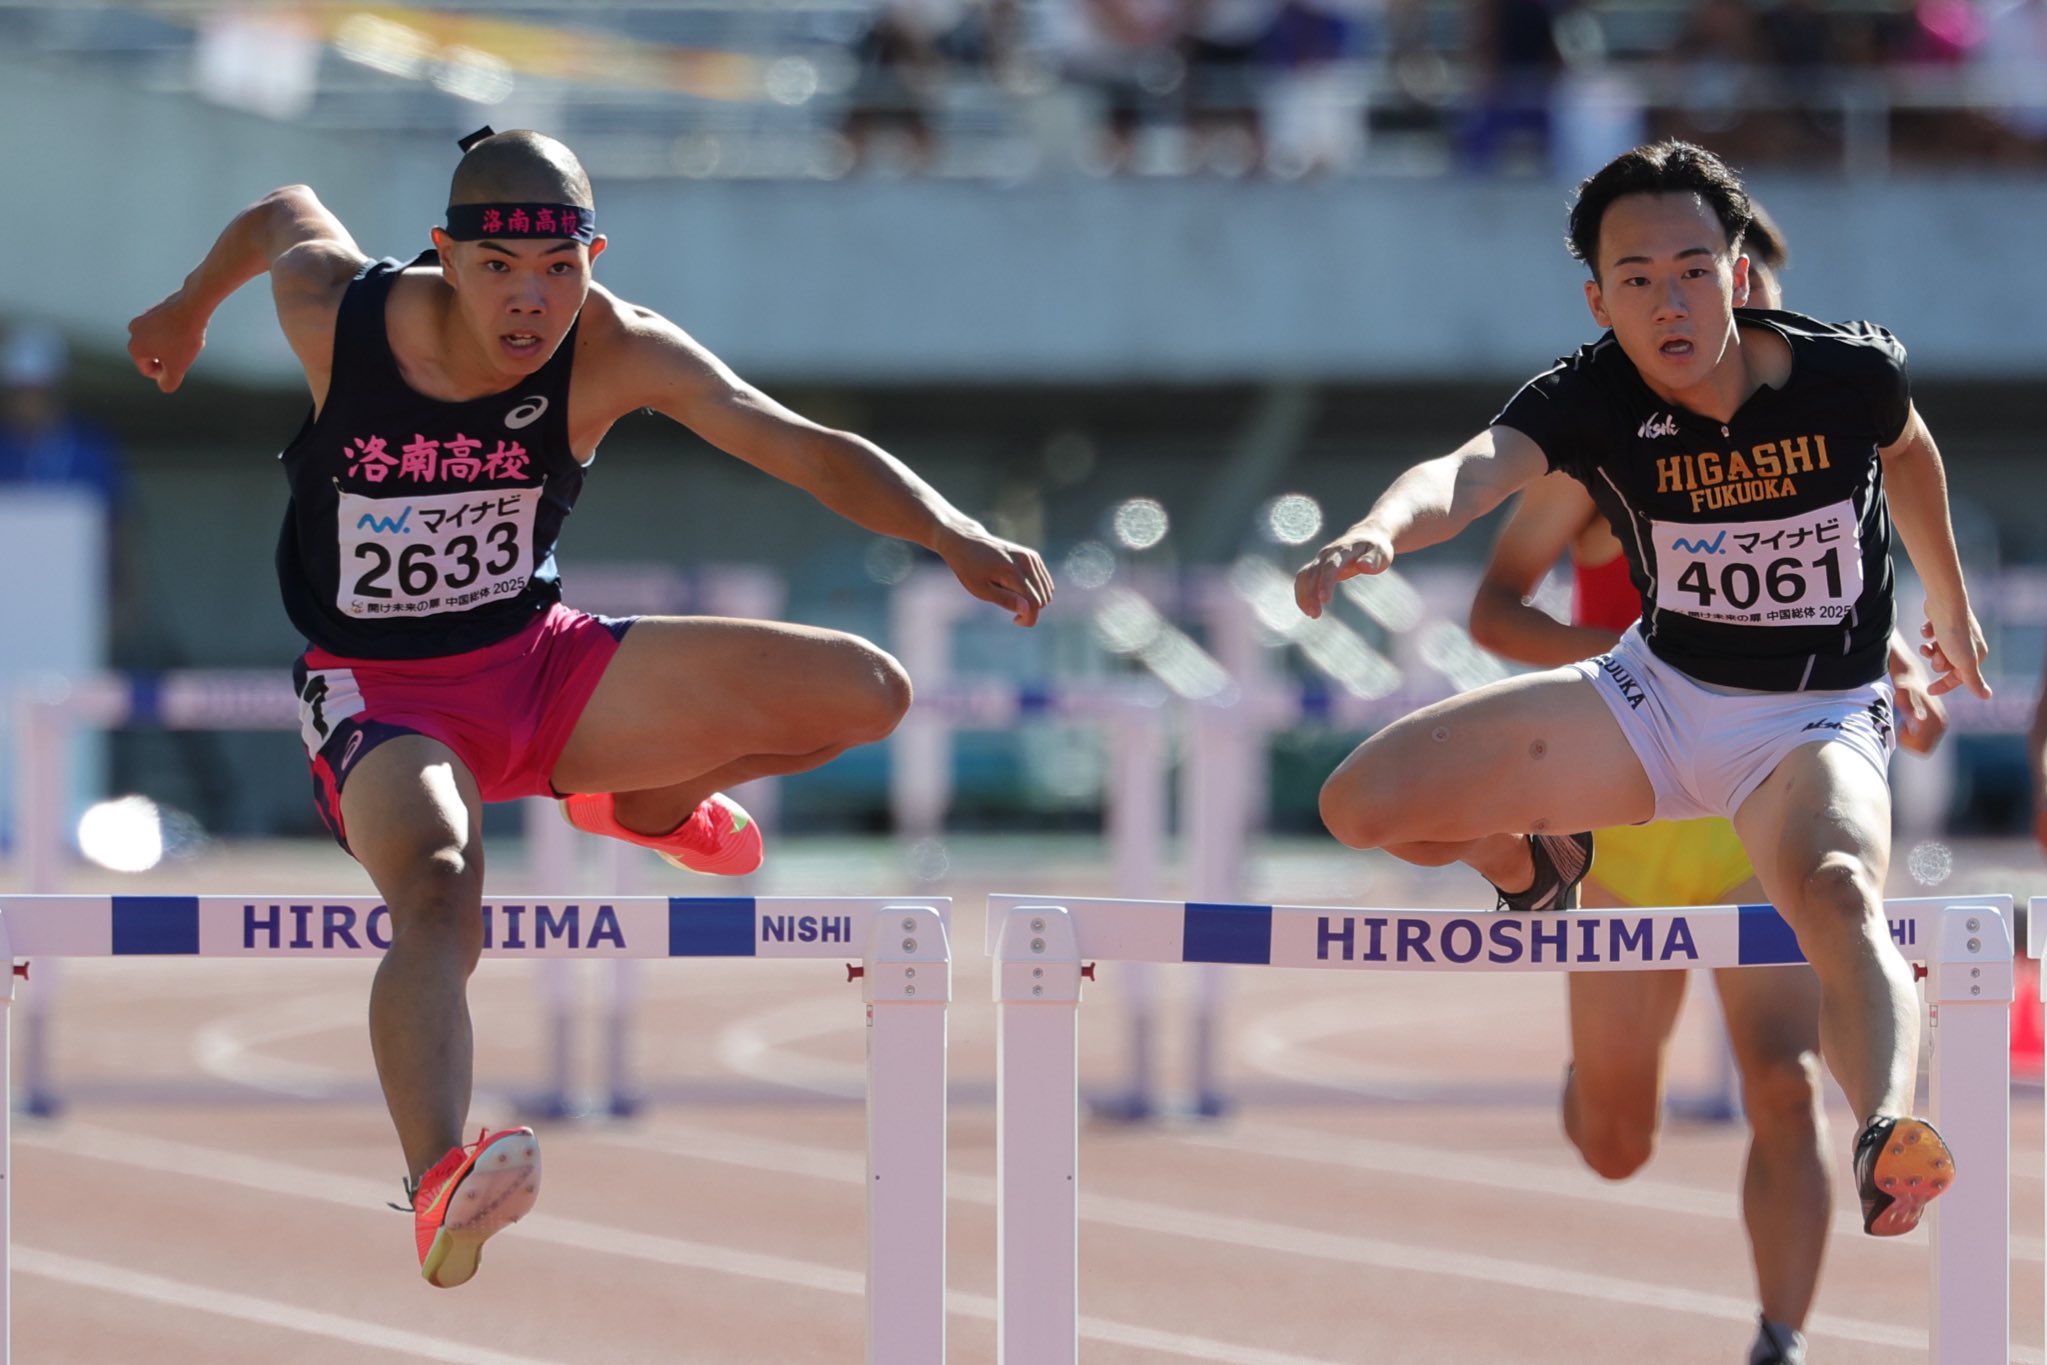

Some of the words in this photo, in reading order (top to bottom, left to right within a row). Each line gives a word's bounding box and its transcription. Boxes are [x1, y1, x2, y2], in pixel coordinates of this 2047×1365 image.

[482, 208, 579, 236] 洛南高校
[344, 433, 530, 482] 洛南高校
[1656, 435, 1831, 493] HIGASHI
[419, 495, 521, 533] マイナビ
[1690, 477, 1798, 513] FUKUOKA
[1733, 518, 1841, 553] マイナビ
[353, 521, 519, 598] 2633
[1677, 547, 1843, 610] 4061
[493, 576, 526, 595] 2025
[243, 905, 627, 949] HIROIMA
[762, 915, 851, 942] NISHI
[1316, 916, 1699, 963] HIROSHIMA
